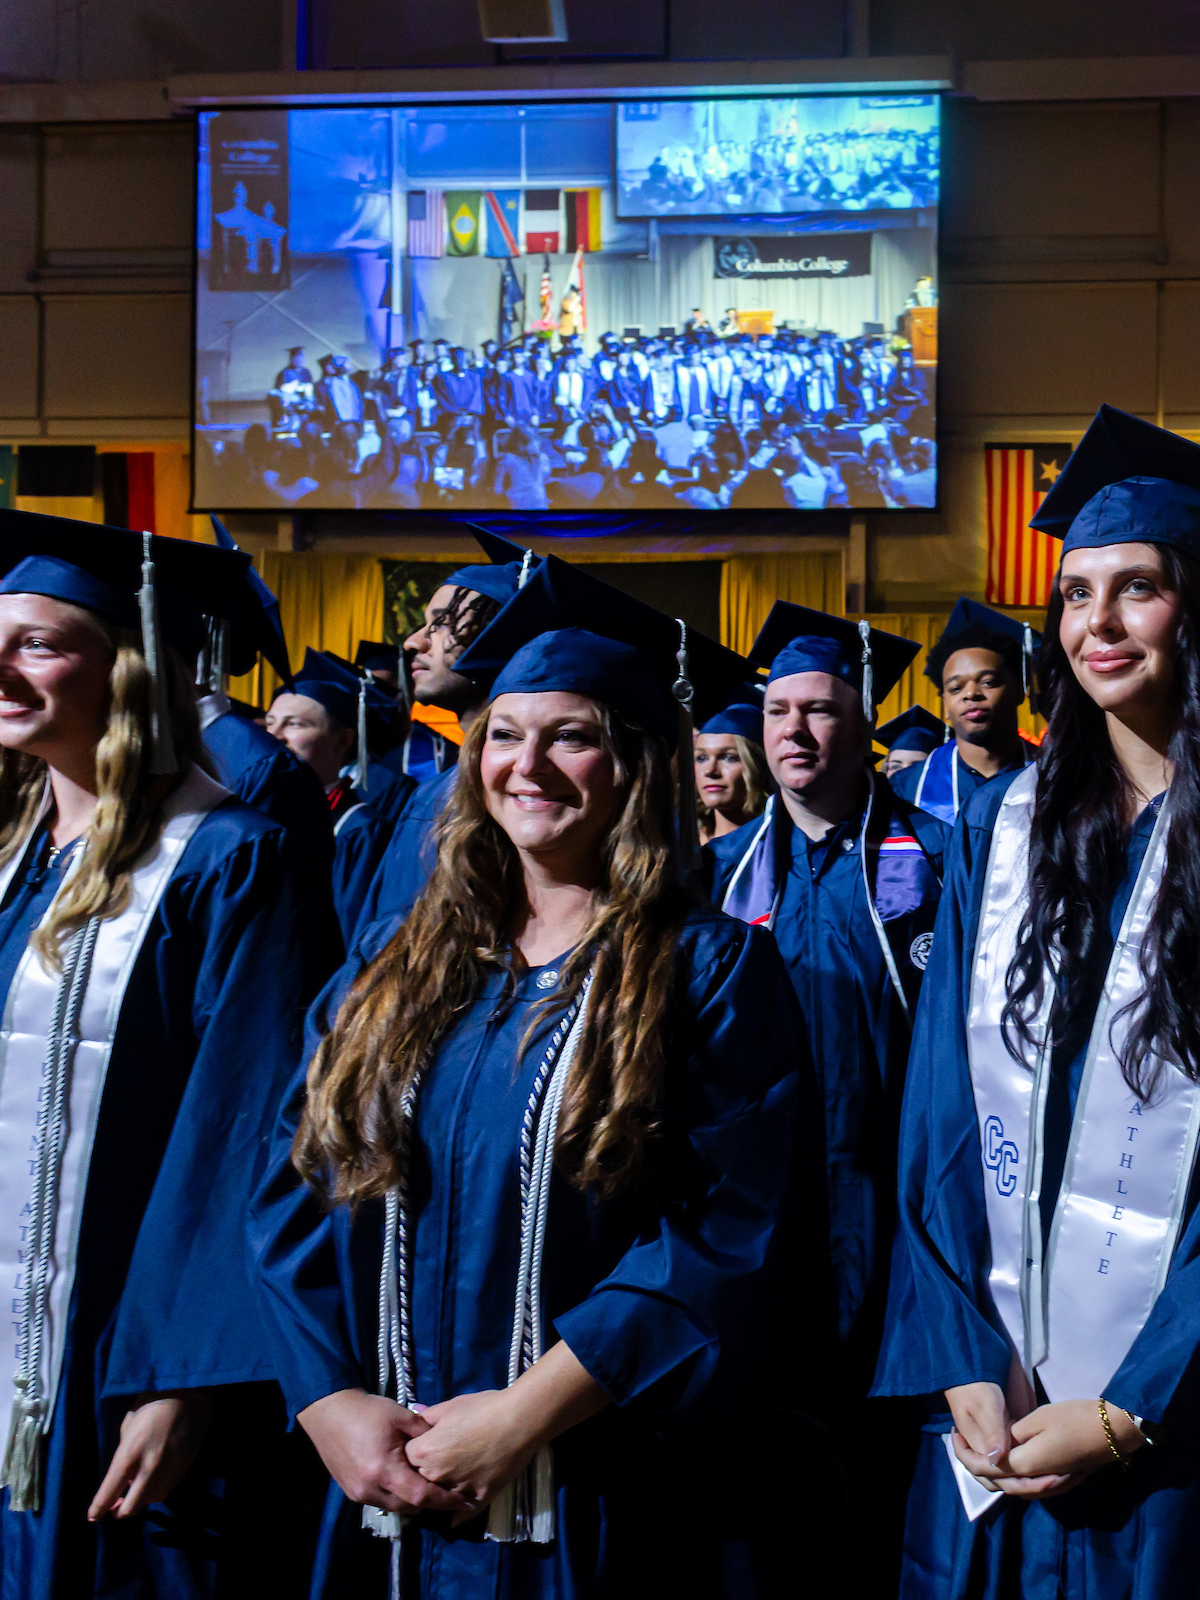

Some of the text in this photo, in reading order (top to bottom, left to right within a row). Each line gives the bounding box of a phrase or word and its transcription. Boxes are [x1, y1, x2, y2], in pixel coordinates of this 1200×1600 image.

[735, 256, 849, 274] Columbia College
[982, 1115, 1019, 1197] CC
[1097, 1101, 1143, 1275] ATHLETE
